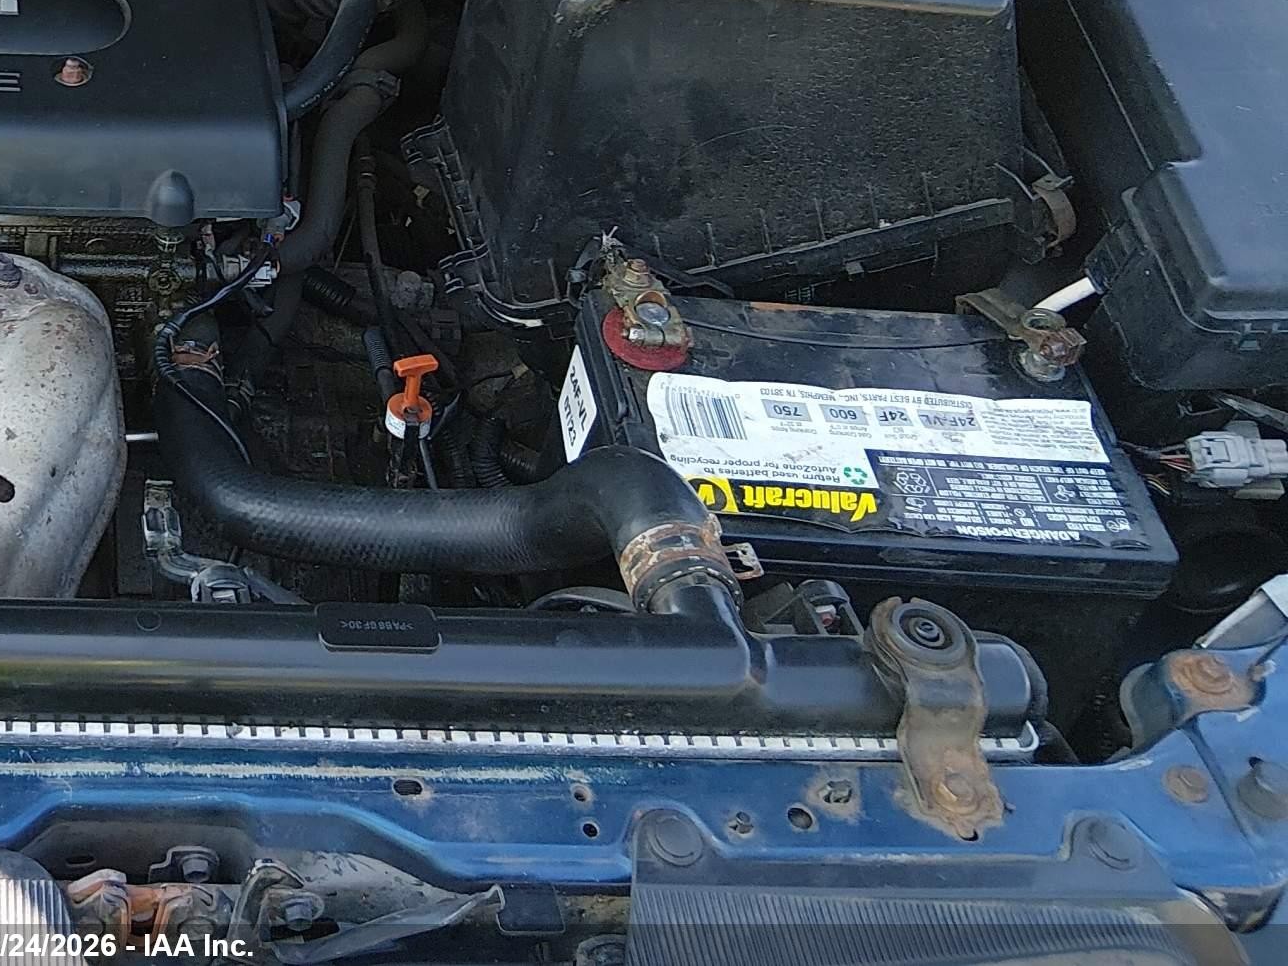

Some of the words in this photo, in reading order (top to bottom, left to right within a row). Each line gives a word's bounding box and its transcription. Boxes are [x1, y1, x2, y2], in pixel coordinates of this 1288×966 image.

[890, 395, 910, 404] BEST
[773, 404, 801, 417] 750
[829, 408, 857, 420] 600
[878, 410, 908, 423] 24F
[919, 414, 976, 427] 24F-VL
[669, 454, 720, 465] recycling
[724, 458, 761, 468] proper
[704, 467, 715, 475] to
[764, 462, 779, 471] for
[782, 463, 838, 474] AutoZone
[718, 467, 769, 480] batteries
[772, 470, 798, 480] used
[802, 473, 840, 484] Return
[739, 485, 877, 522] Valucraft
